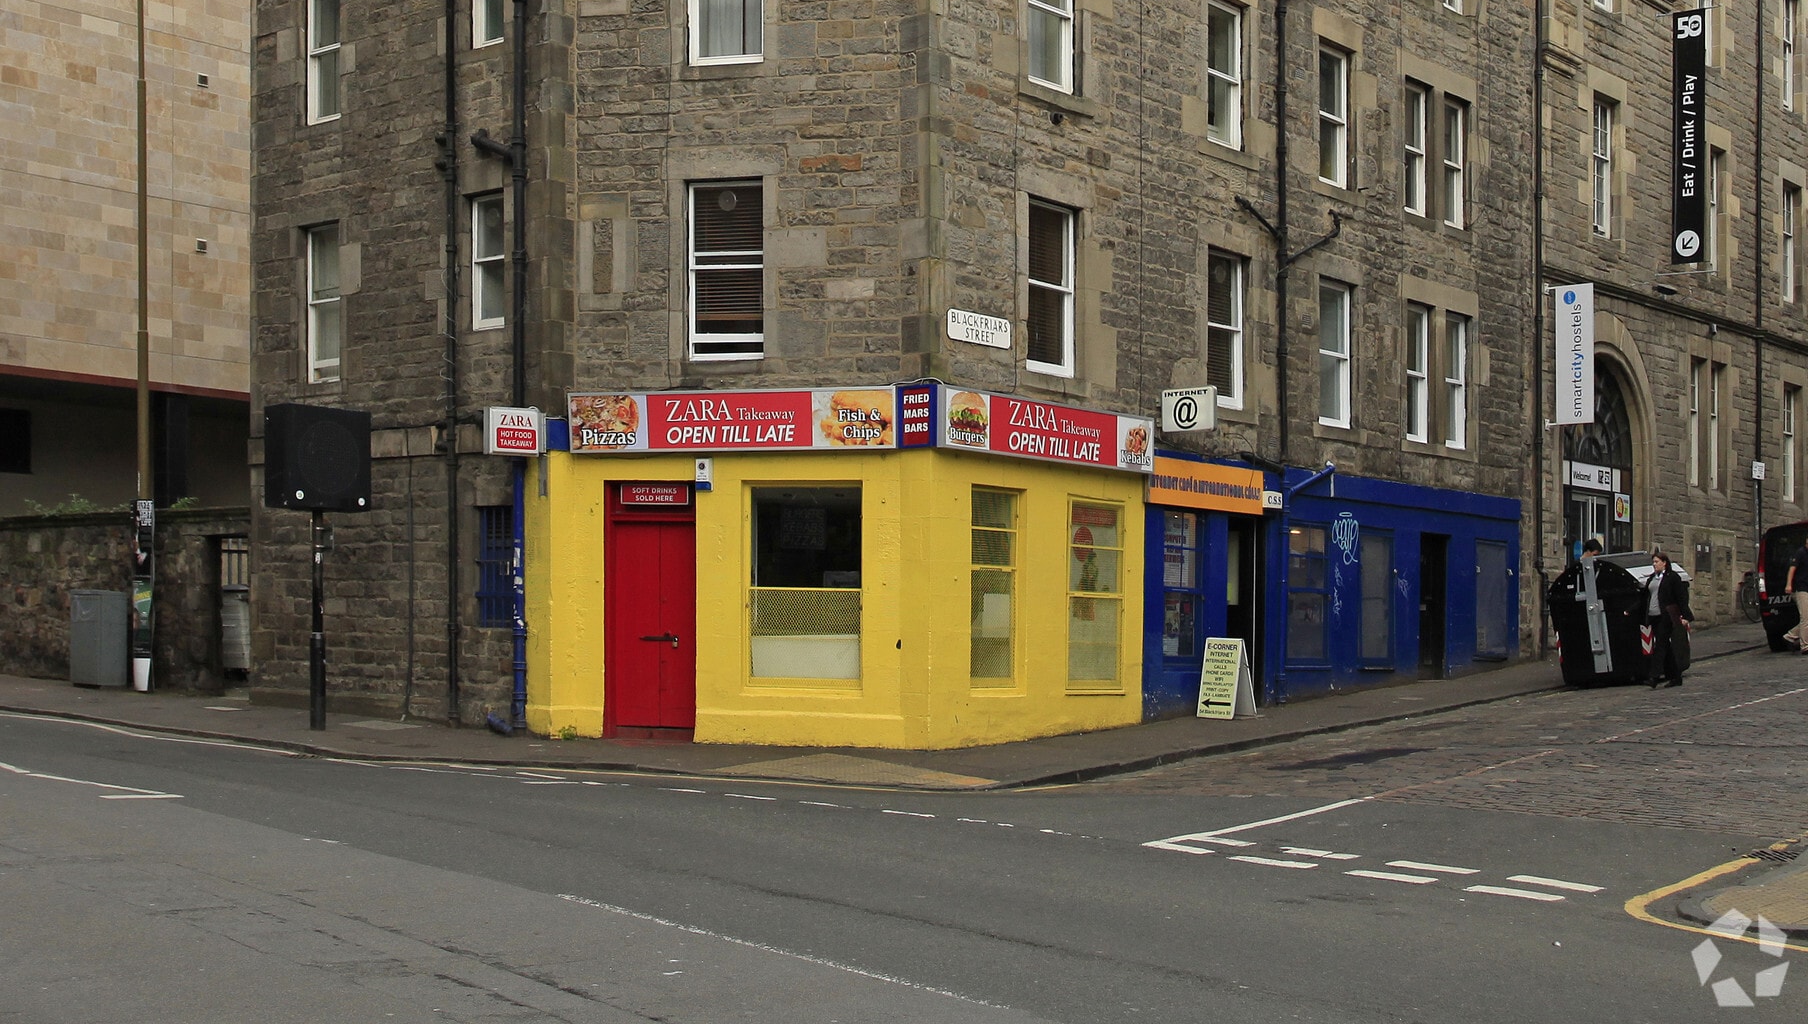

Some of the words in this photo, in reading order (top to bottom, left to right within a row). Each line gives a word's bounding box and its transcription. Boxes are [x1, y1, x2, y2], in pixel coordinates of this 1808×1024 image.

[1682, 74, 1698, 105] Play
[1682, 120, 1695, 158] Drink
[1682, 173, 1694, 197] Eat
[951, 312, 1008, 333] BLACKFRIARS
[966, 328, 995, 344] STREET
[1571, 304, 1584, 418] smartcityhostels
[904, 394, 930, 404] FRIED
[1164, 389, 1208, 398] INTERNET
[665, 398, 733, 422] ZARA
[736, 407, 795, 422] Takeaway
[838, 408, 866, 422] Fish
[870, 408, 881, 421] &
[904, 408, 929, 418] MARS
[500, 414, 532, 427] ZARA
[904, 422, 928, 433] BARS
[1008, 400, 1058, 432] ZARA
[1060, 419, 1100, 442] Takeaway
[500, 430, 514, 438] HOT
[581, 428, 636, 446] Pizzas
[666, 425, 716, 444] OPEN
[722, 425, 750, 443] TILL
[756, 424, 795, 442] LATE
[843, 426, 880, 440] Chips
[950, 427, 985, 445] Burgers
[500, 439, 533, 448] TAKEAWAY
[1008, 432, 1046, 454] OPEN
[1049, 436, 1070, 458] TILL
[1074, 441, 1100, 462] LATE
[1120, 449, 1151, 466] Kebabs
[1768, 595, 1792, 604] TAXI
